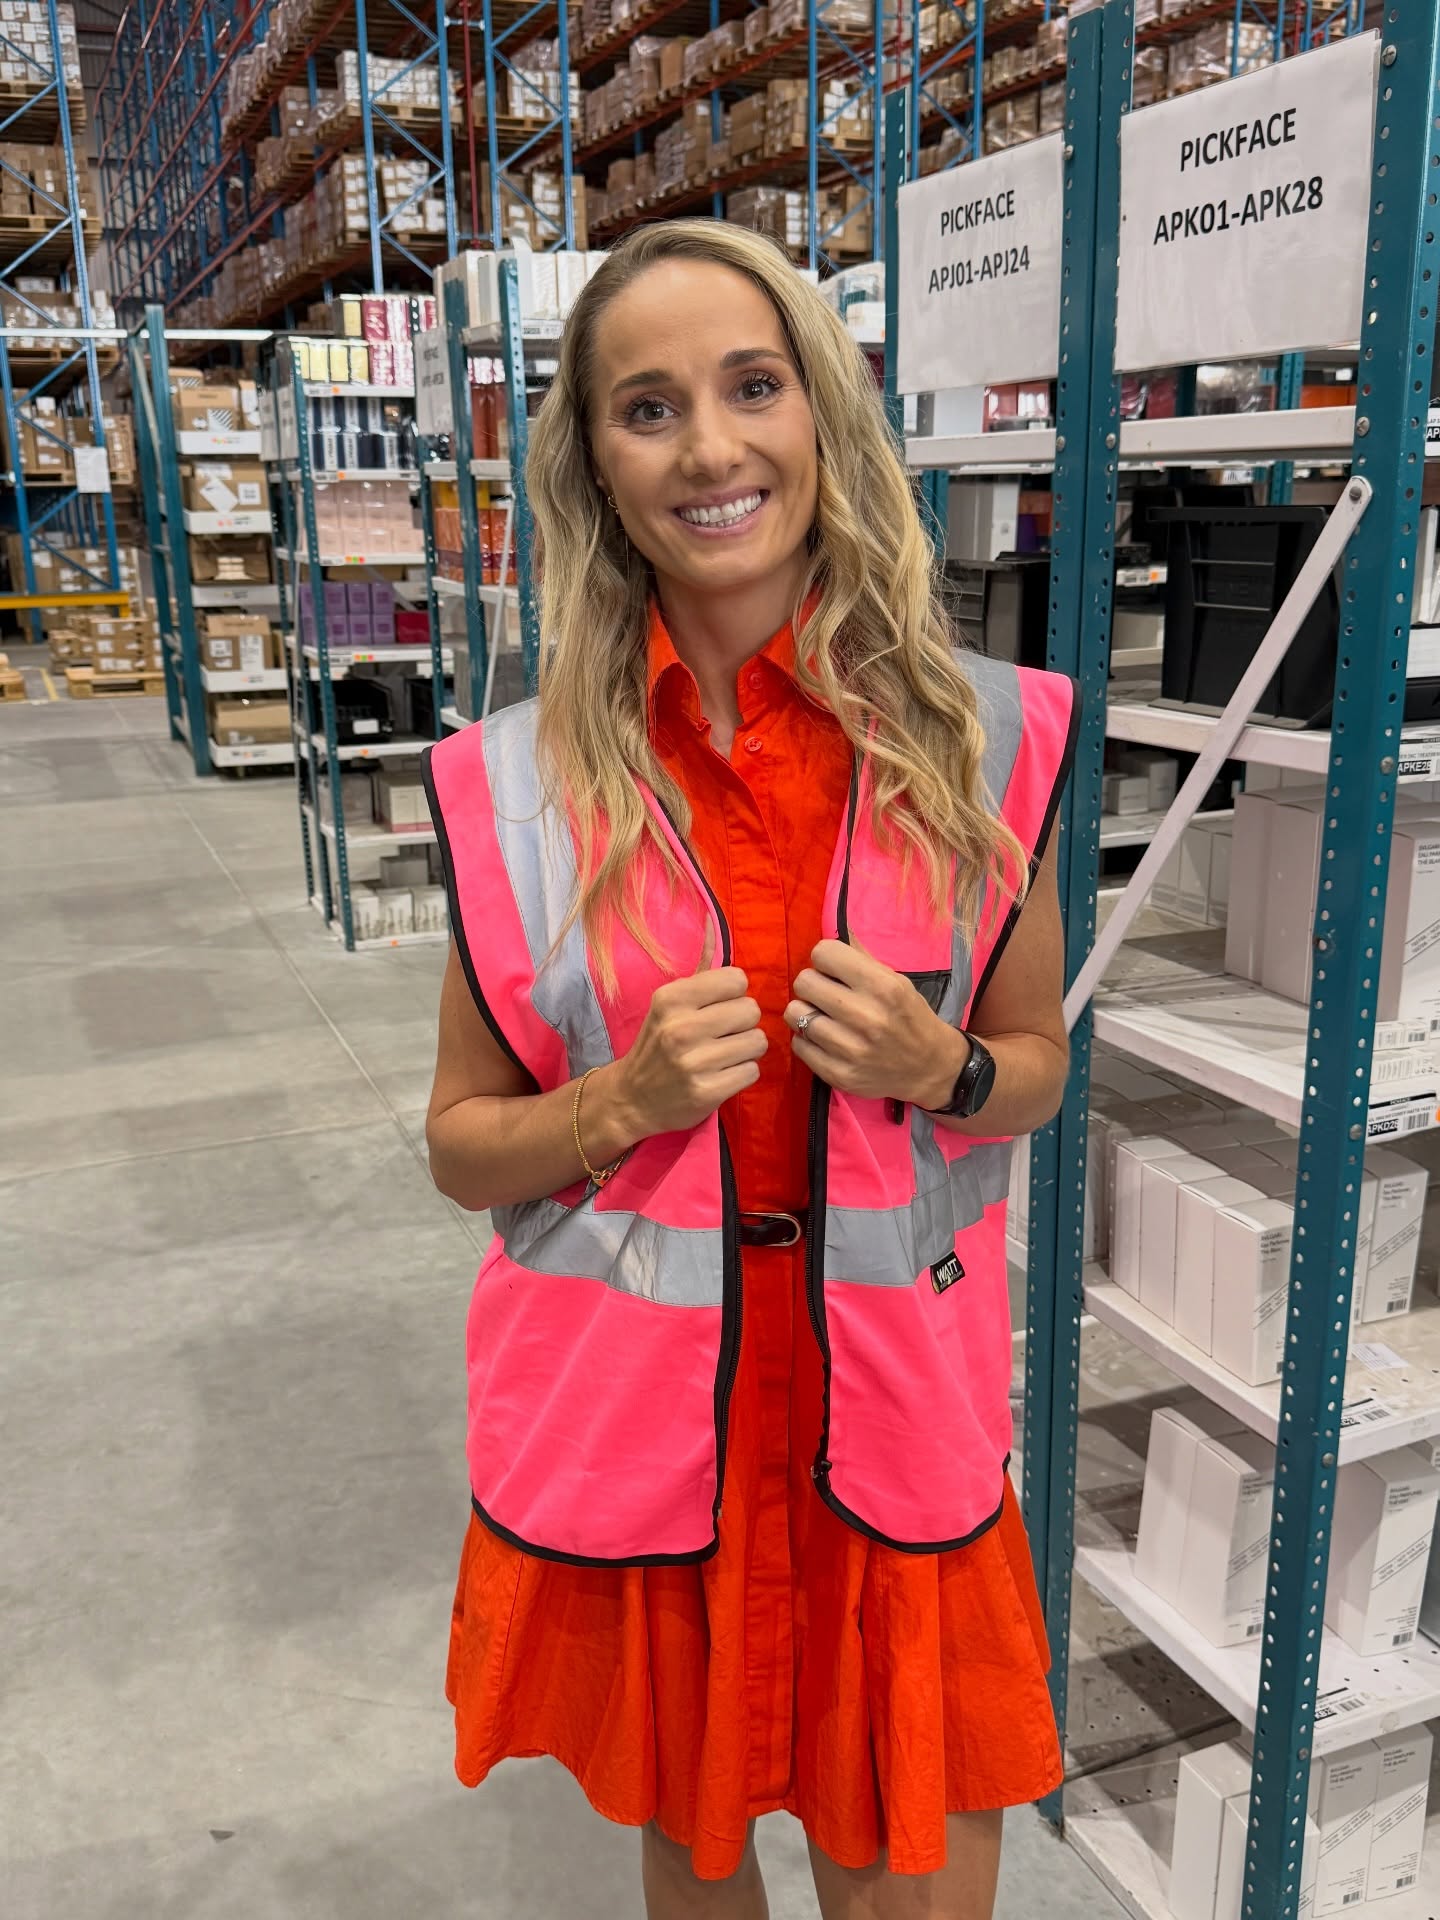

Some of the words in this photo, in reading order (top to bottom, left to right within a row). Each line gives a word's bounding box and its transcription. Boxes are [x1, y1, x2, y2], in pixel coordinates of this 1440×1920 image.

[1180, 107, 1297, 172] PICKFACE
[941, 189, 1015, 237] PICKFACE
[1153, 175, 1323, 246] APK01-APK28
[928, 244, 1030, 294] APJ01-APJ24
[1426, 427, 1440, 439] AP
[936, 1257, 958, 1285] WATT
